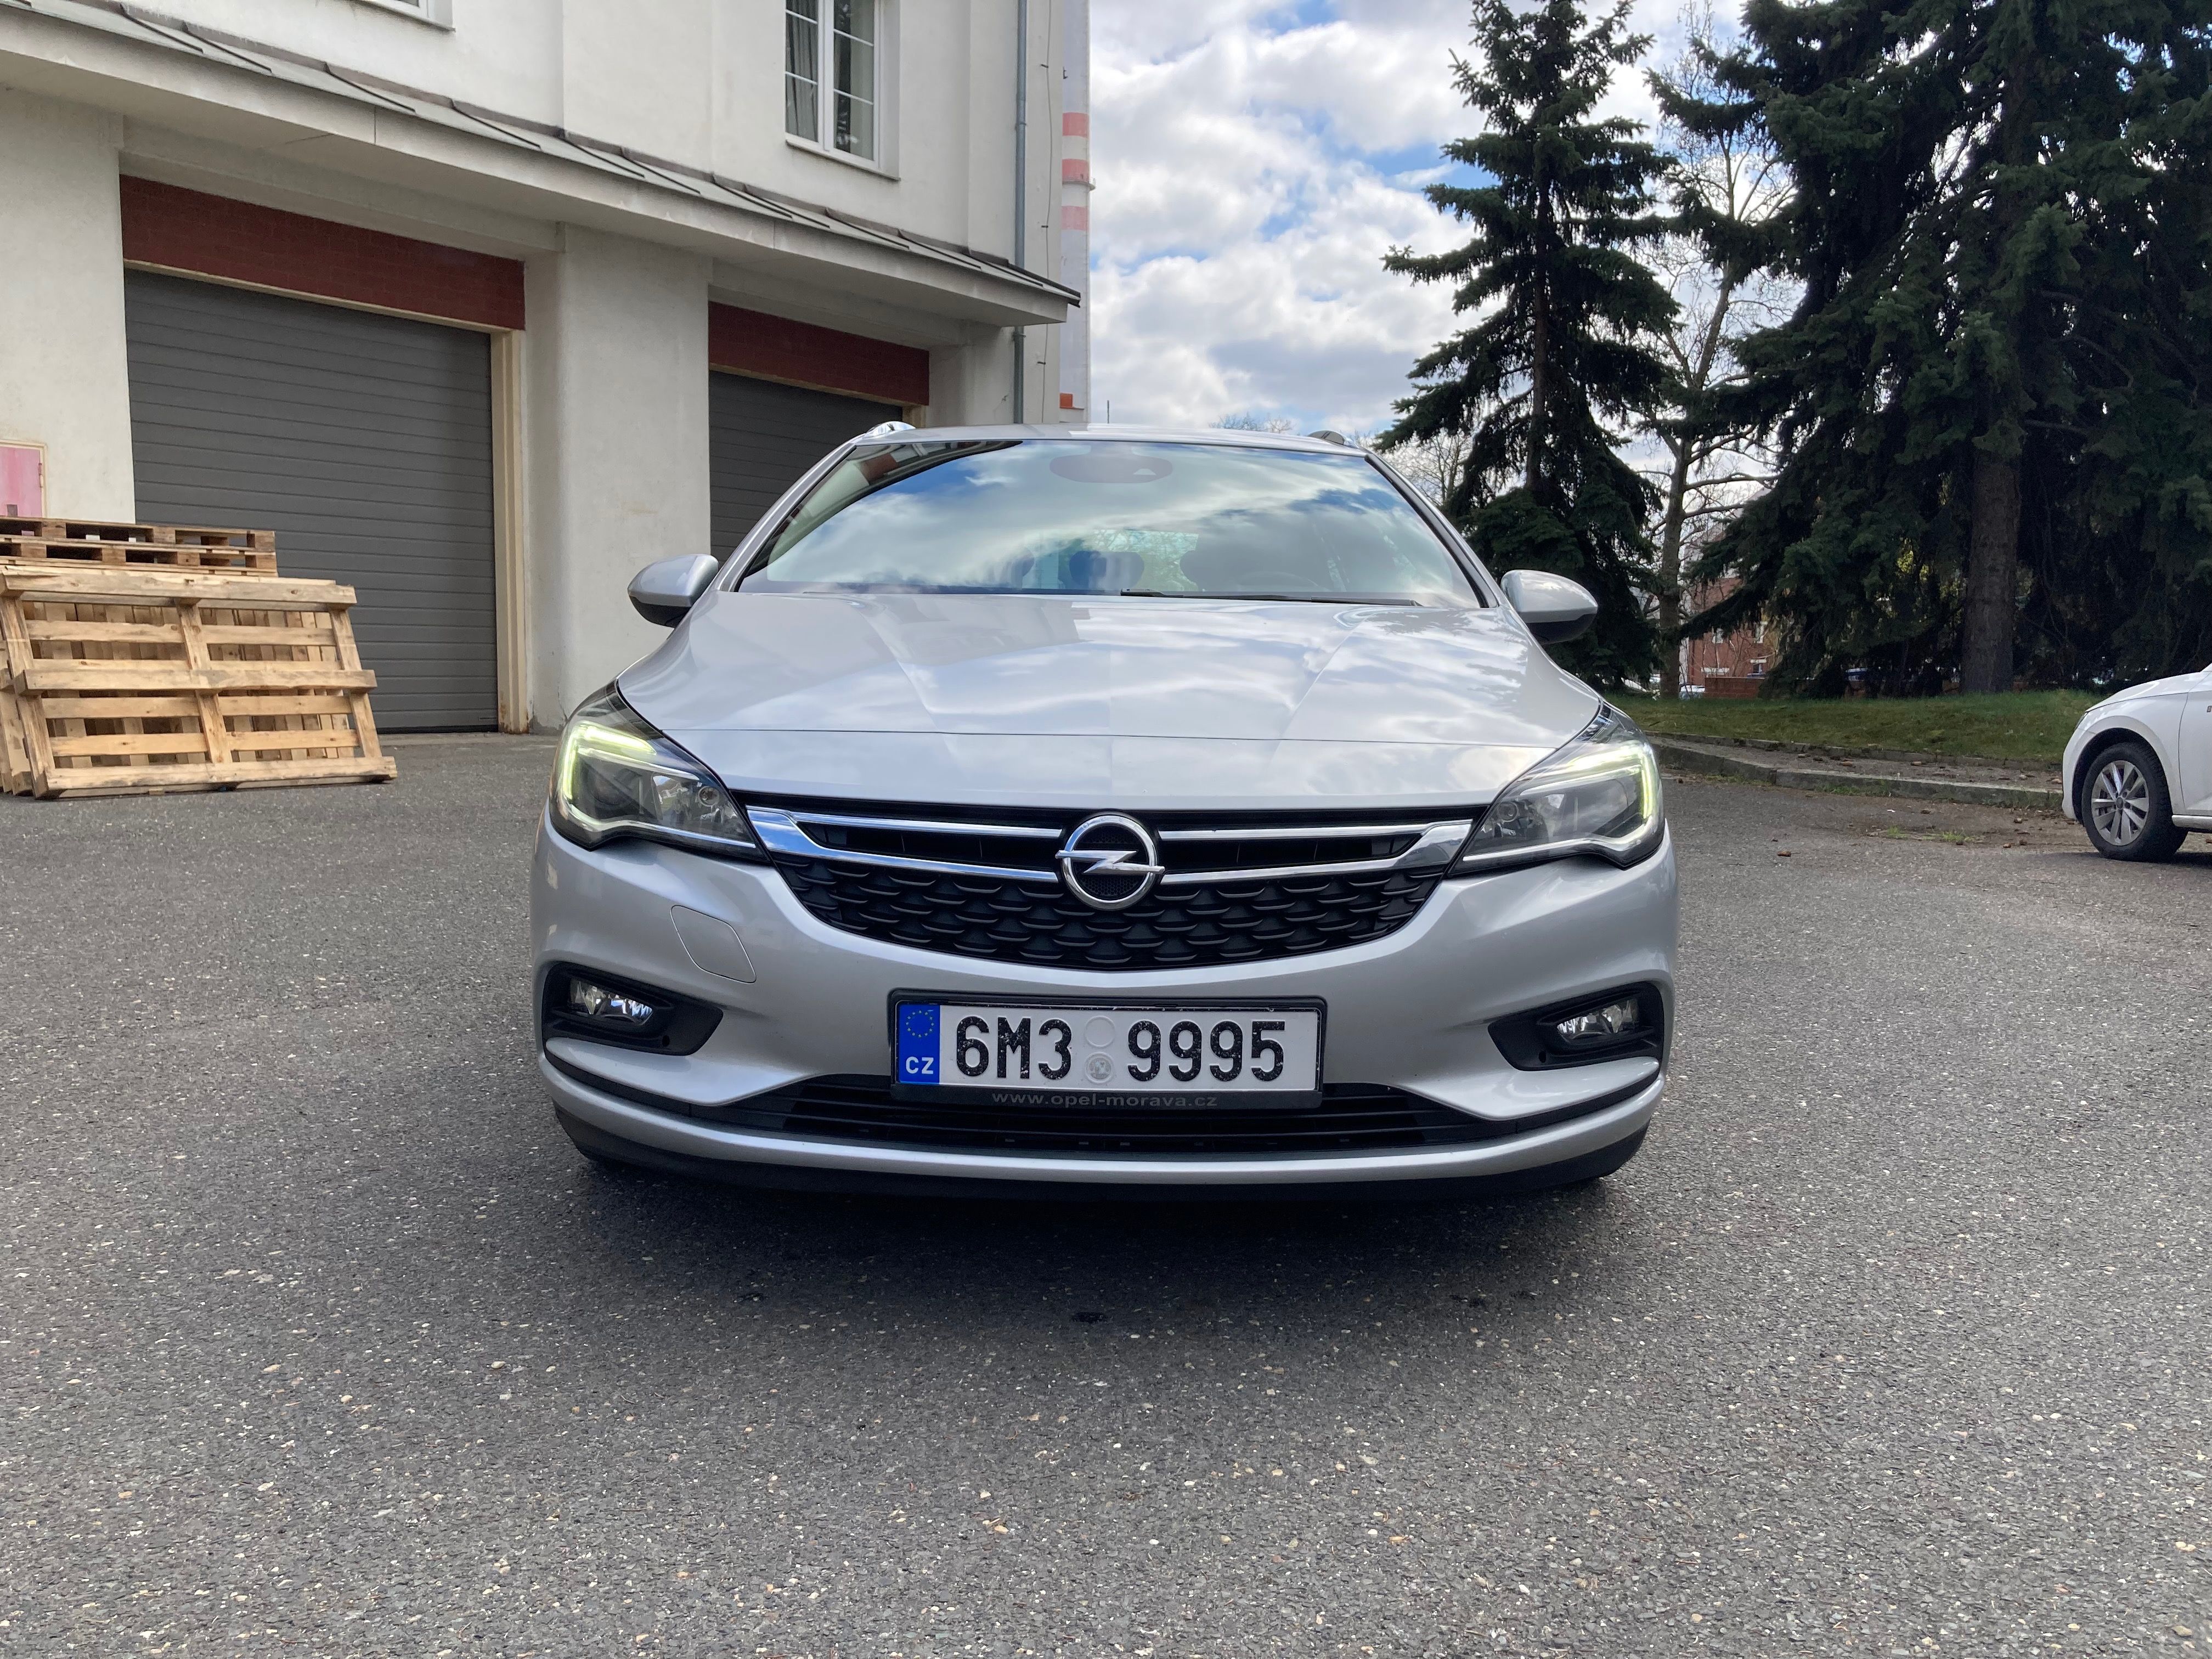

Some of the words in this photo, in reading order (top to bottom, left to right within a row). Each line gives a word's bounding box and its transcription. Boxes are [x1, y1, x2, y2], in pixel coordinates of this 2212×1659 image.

[956, 1016, 1072, 1080] 6M3
[1127, 1020, 1285, 1081] 9995
[905, 1057, 934, 1074] CZ
[992, 1093, 1217, 1108] www.opel-morava.cz
